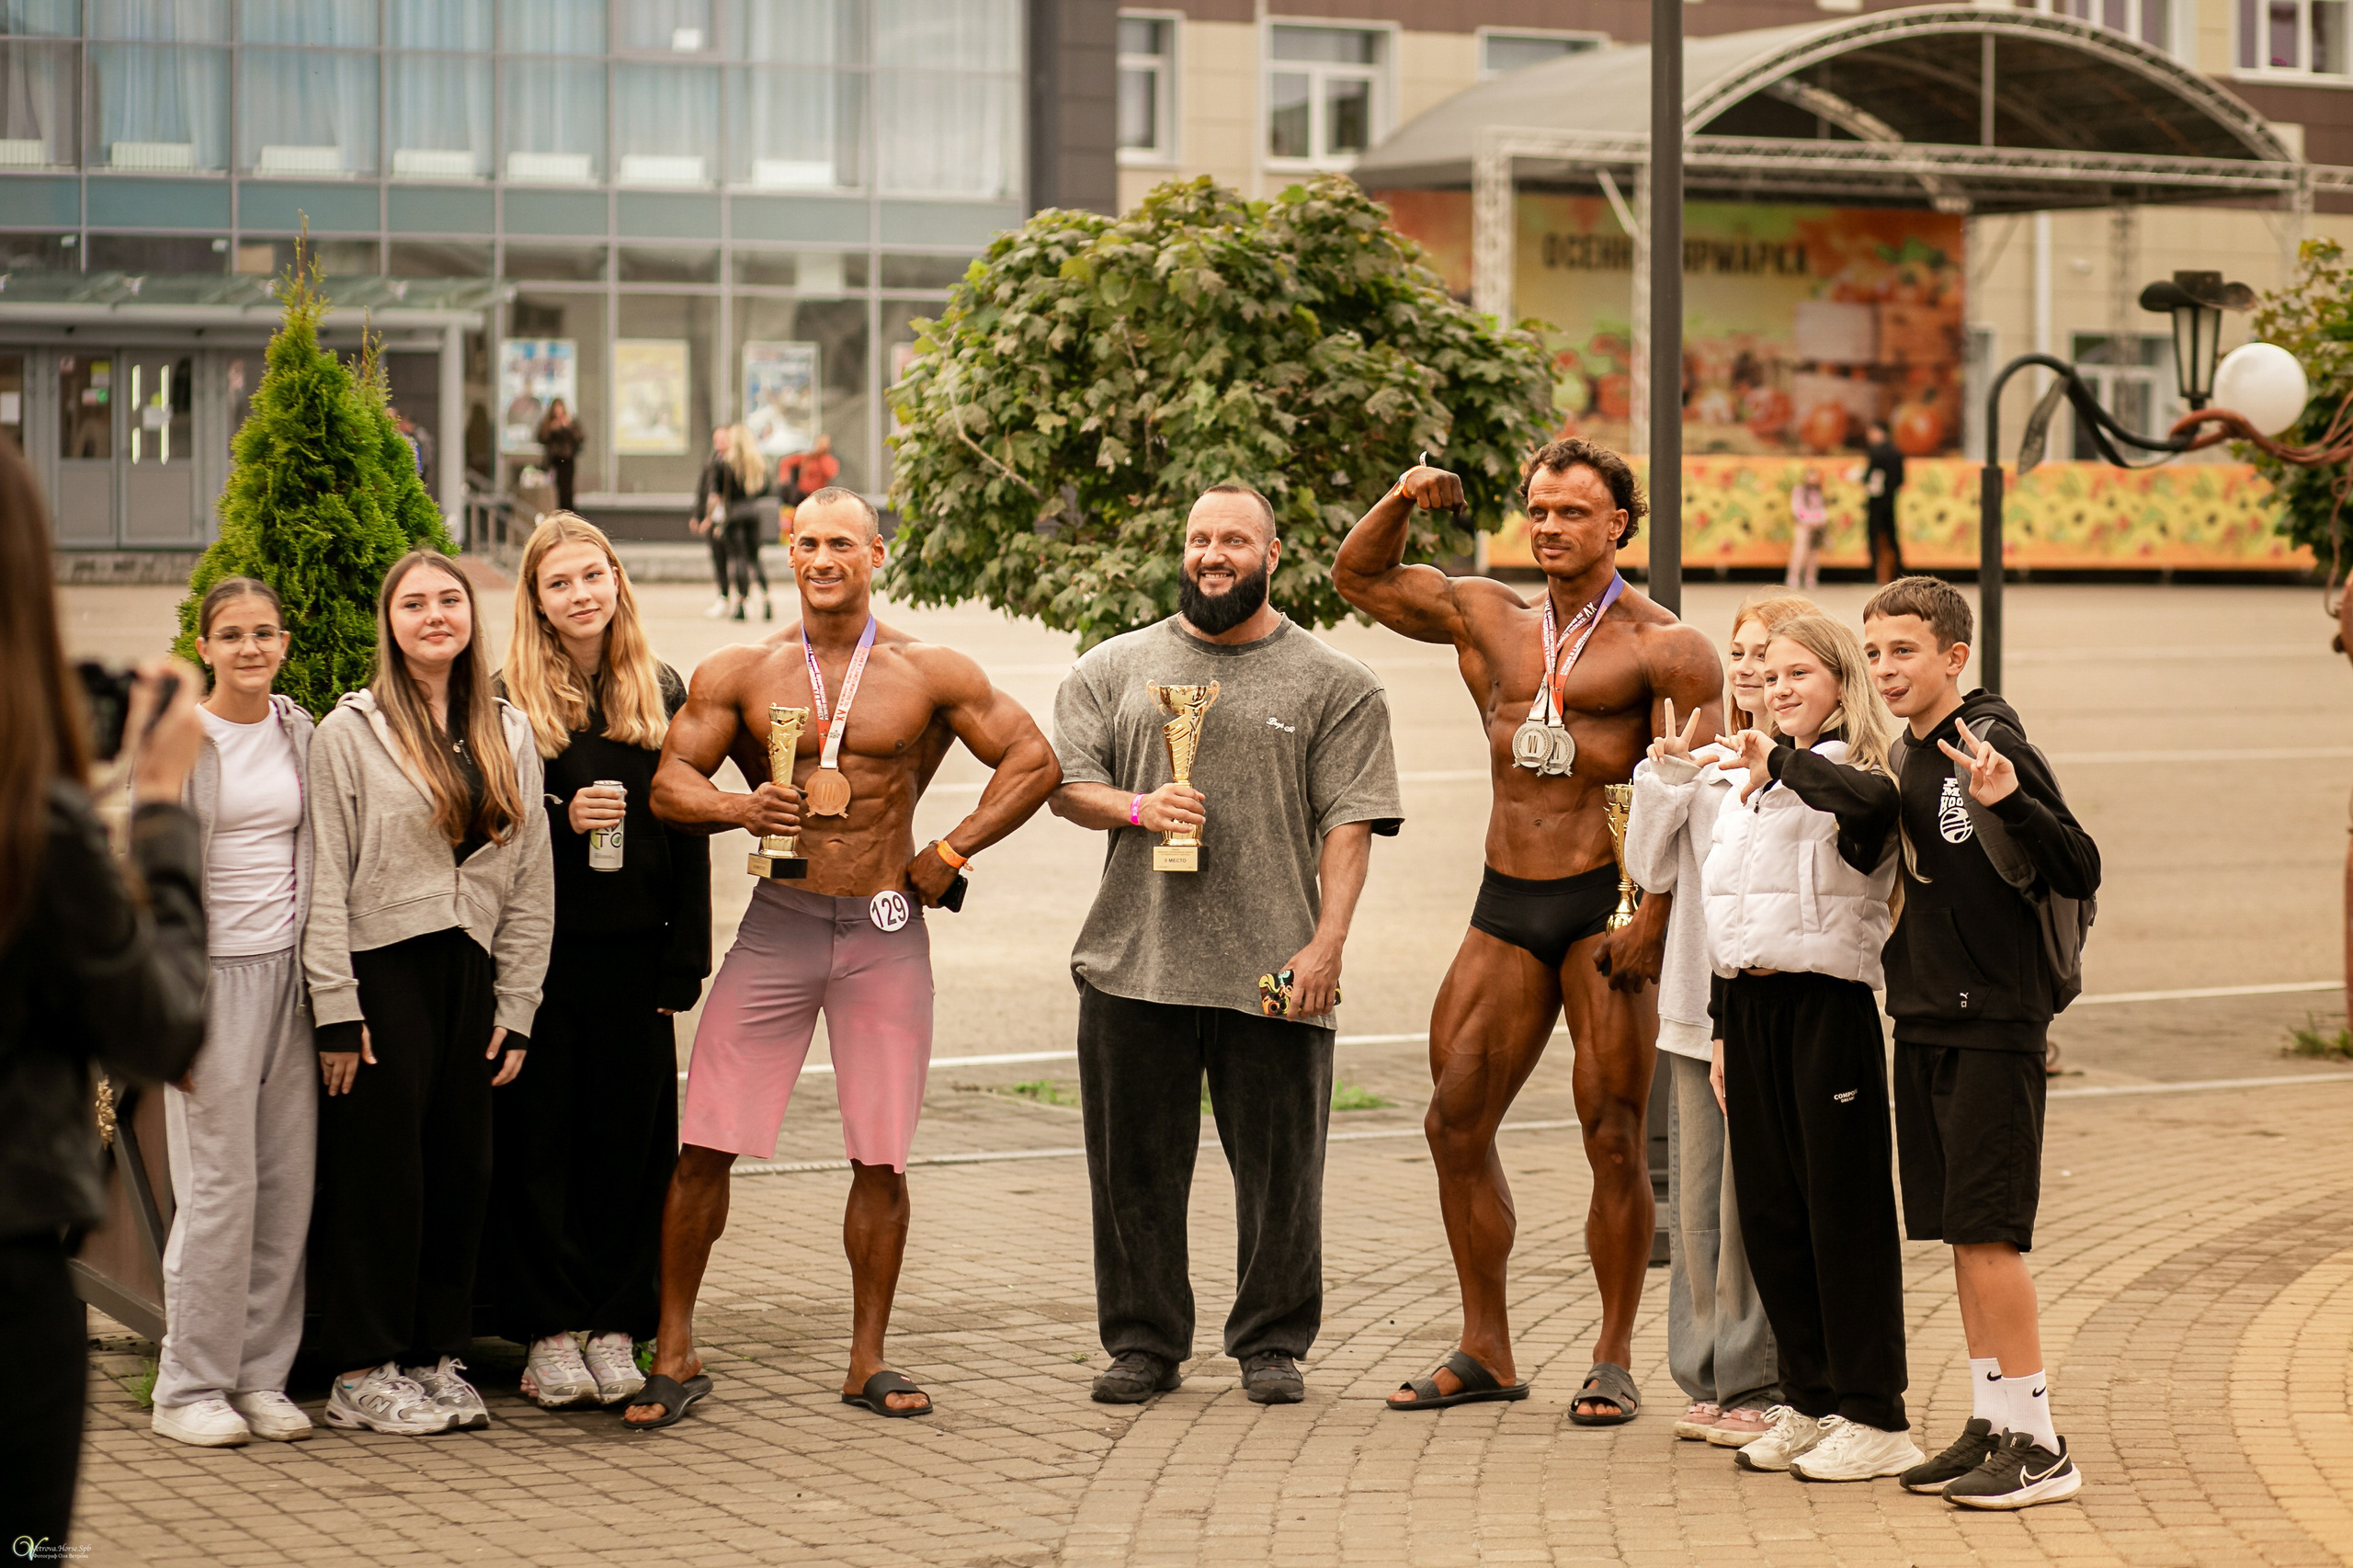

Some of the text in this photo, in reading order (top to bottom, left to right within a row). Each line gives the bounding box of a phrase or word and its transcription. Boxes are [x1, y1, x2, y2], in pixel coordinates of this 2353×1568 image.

[1943, 778, 1959, 787] P
[1941, 787, 1961, 797] M
[1938, 796, 1964, 817] HOO
[871, 893, 906, 928] 129
